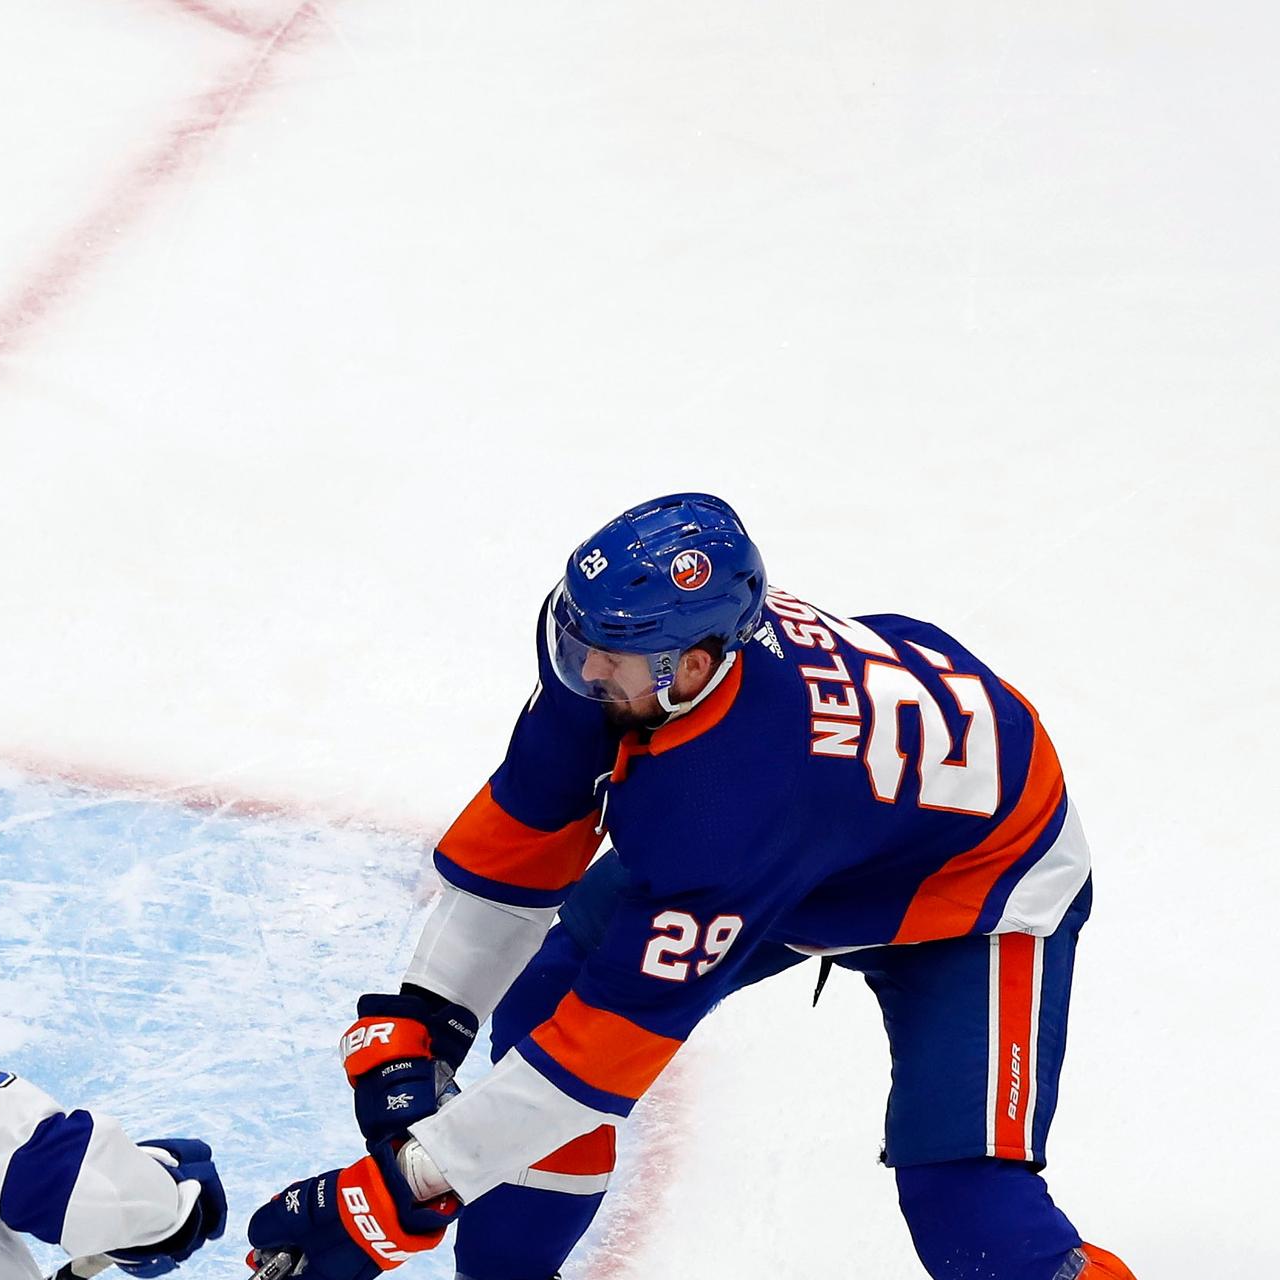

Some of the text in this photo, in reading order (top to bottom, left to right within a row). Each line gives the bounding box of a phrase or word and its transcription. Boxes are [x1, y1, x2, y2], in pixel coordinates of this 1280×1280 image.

[579, 549, 609, 580] 29
[641, 910, 744, 982] 29
[381, 1061, 413, 1078] NELSON
